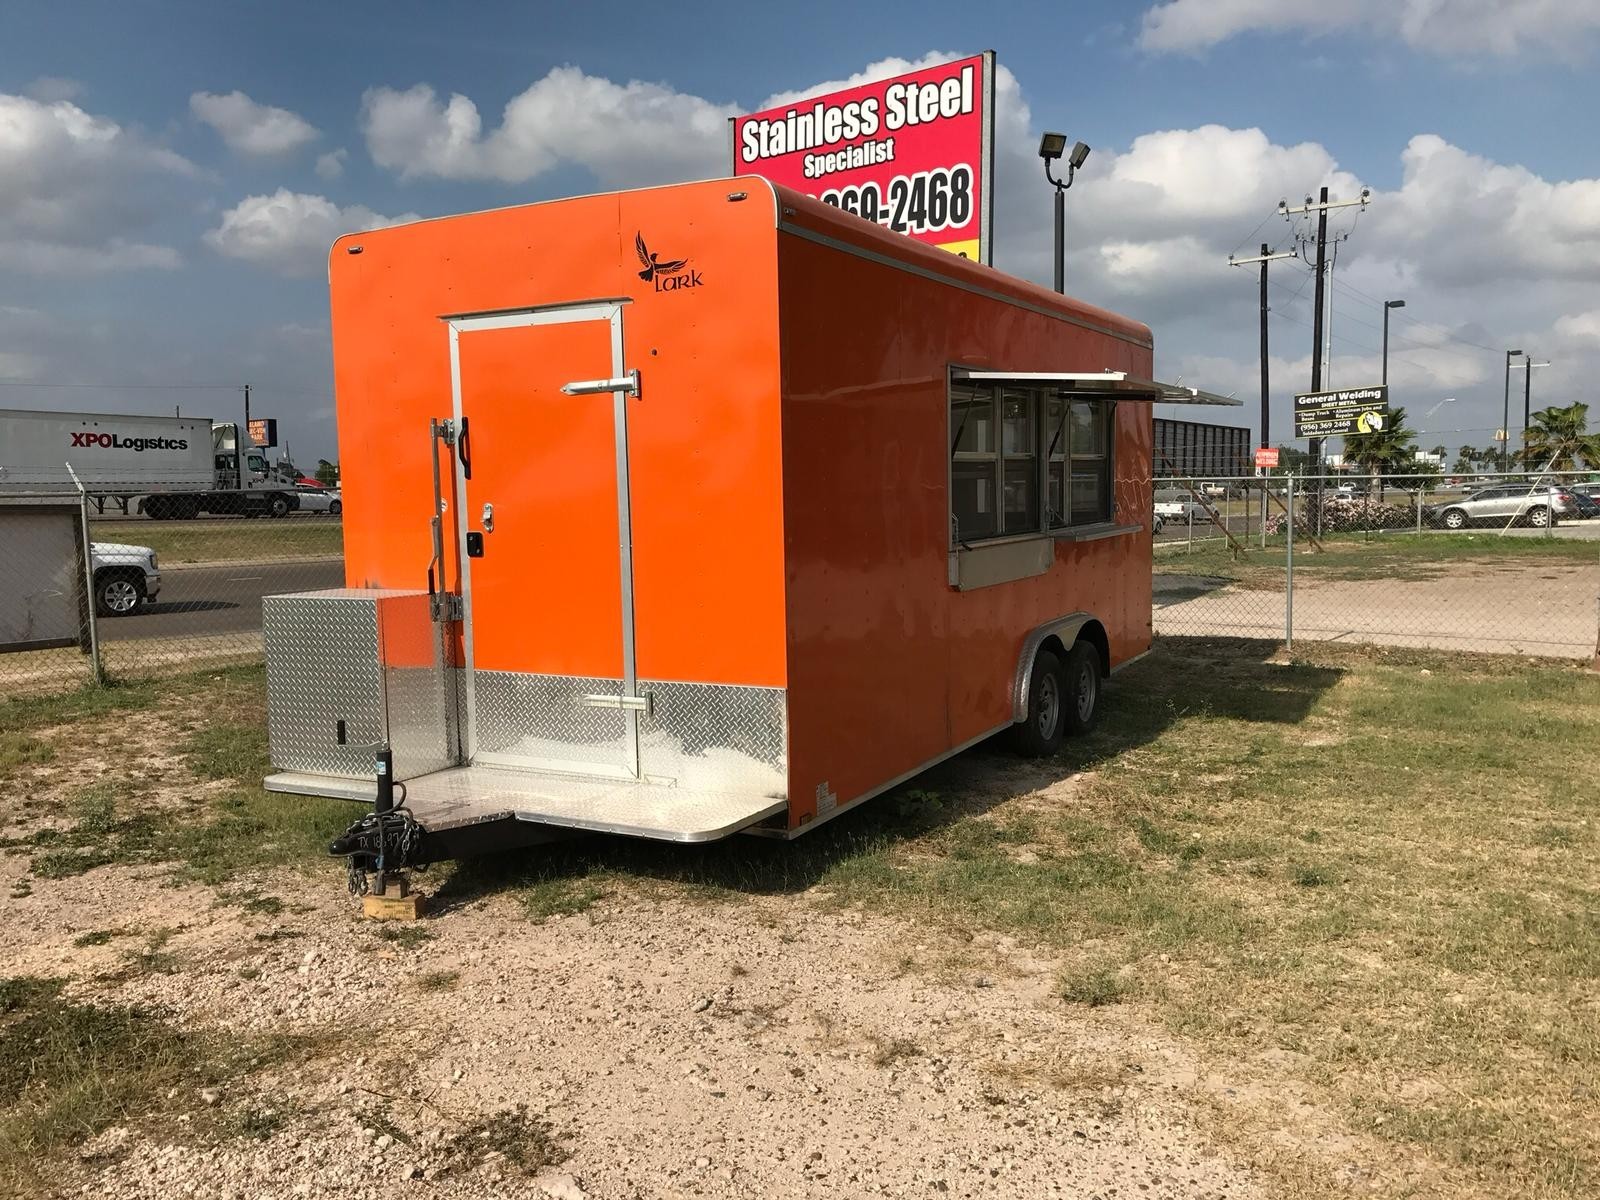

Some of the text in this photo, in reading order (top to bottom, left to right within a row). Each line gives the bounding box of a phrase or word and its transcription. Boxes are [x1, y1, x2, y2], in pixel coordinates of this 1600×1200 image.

[742, 65, 974, 163] Stainless Steel
[804, 137, 896, 179] Specialist
[1298, 390, 1381, 405] General Welding
[1300, 423, 1318, 431] (956)
[357, 836, 369, 848] TX
